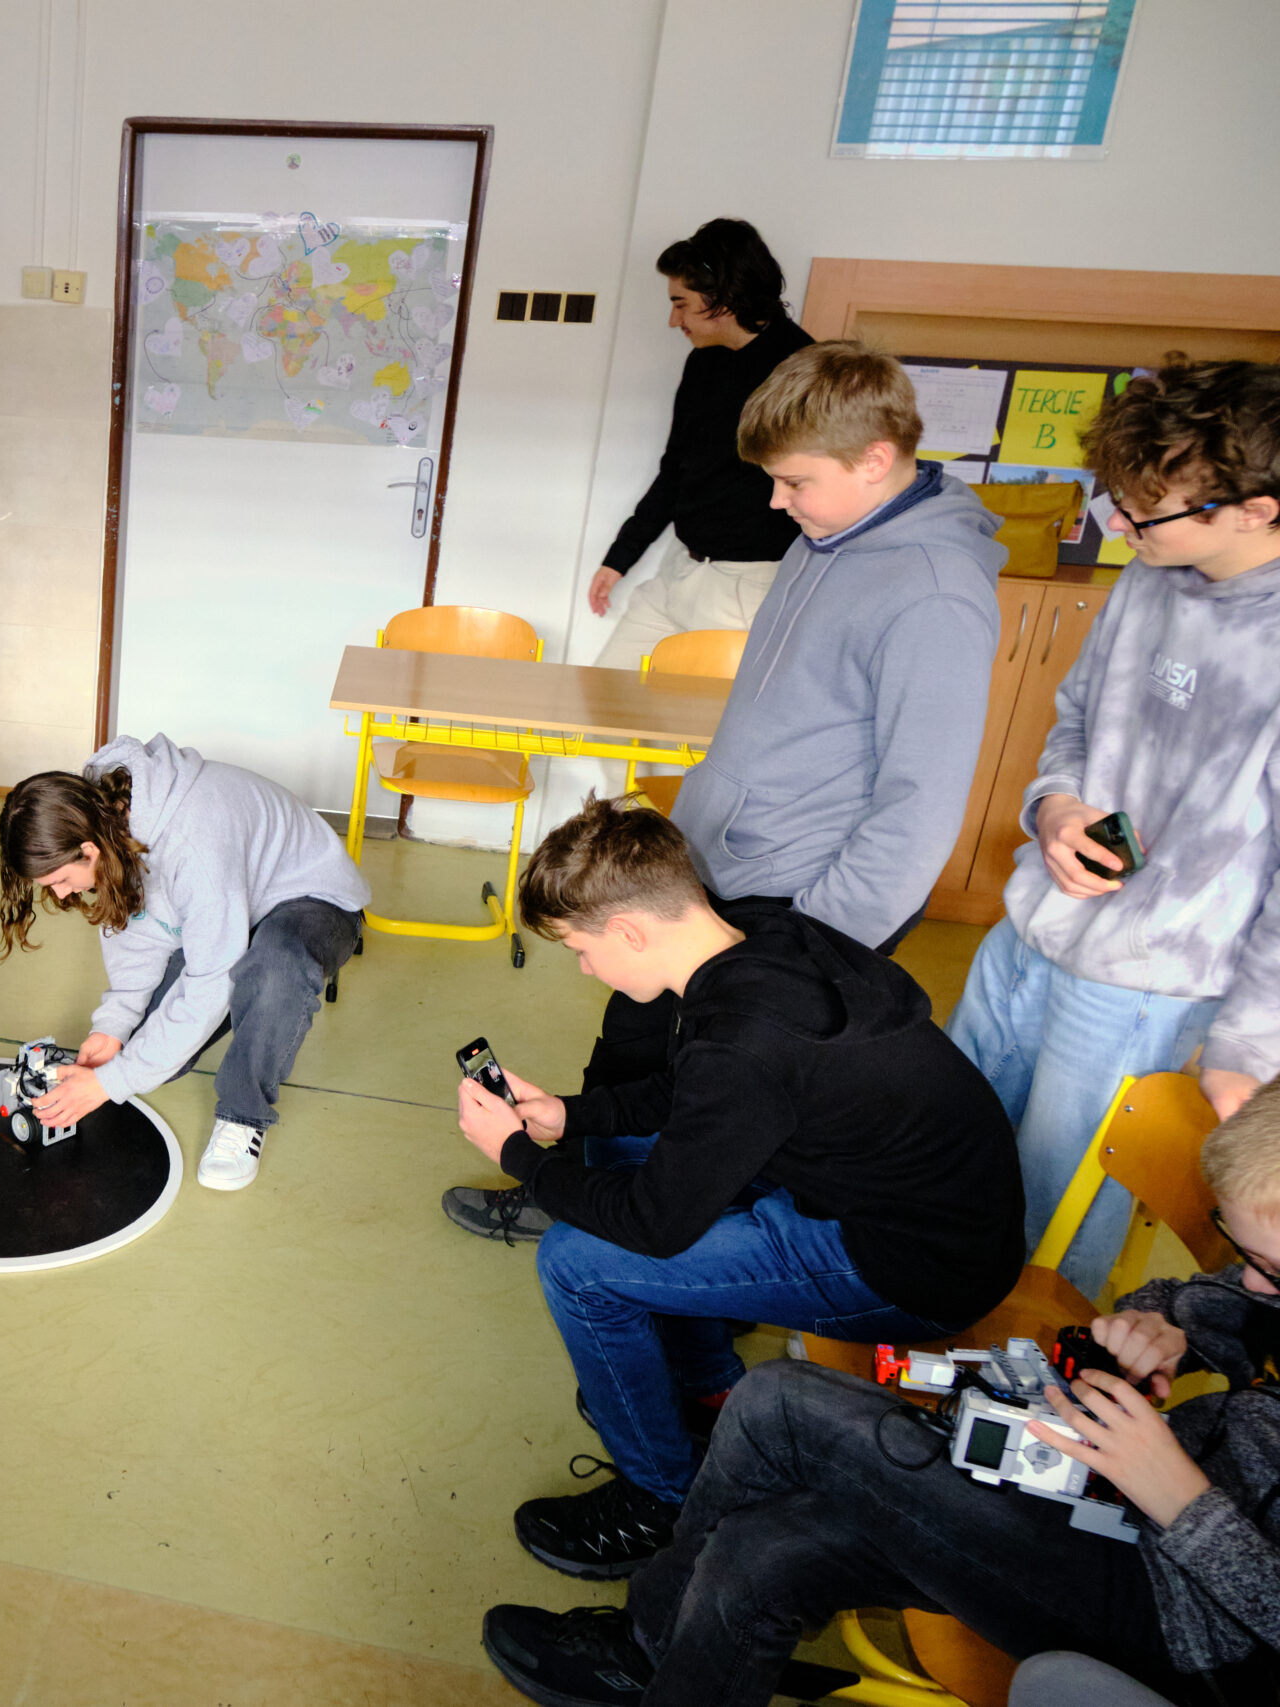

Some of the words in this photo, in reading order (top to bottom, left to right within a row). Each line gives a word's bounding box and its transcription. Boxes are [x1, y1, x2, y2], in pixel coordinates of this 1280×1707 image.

[1017, 388, 1086, 414] TERCIE
[1034, 423, 1056, 449] B
[1151, 653, 1197, 694] NASA
